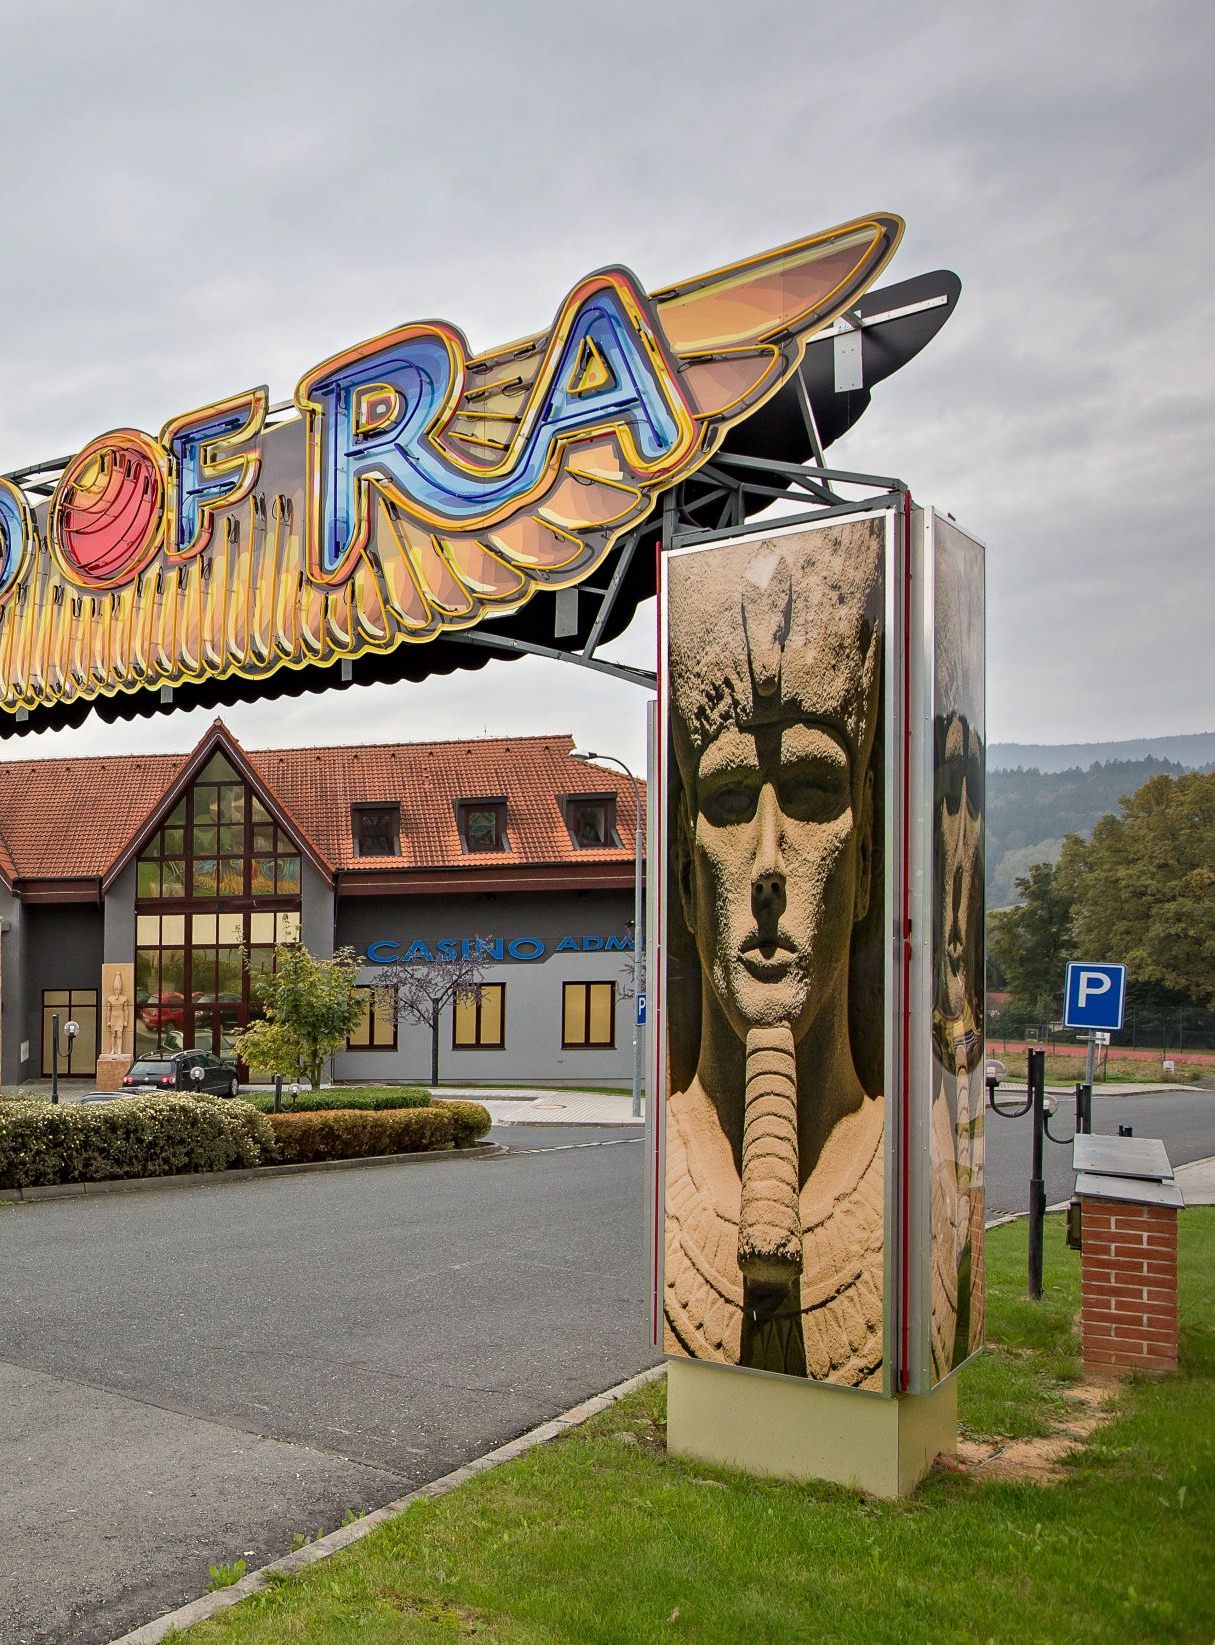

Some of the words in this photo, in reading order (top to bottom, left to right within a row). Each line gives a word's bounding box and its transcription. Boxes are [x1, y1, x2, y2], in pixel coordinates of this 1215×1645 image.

[48, 387, 268, 590] OF
[294, 266, 699, 584] RA
[367, 937, 545, 963] CASINO
[1078, 972, 1111, 1008] P
[638, 997, 646, 1016] P
